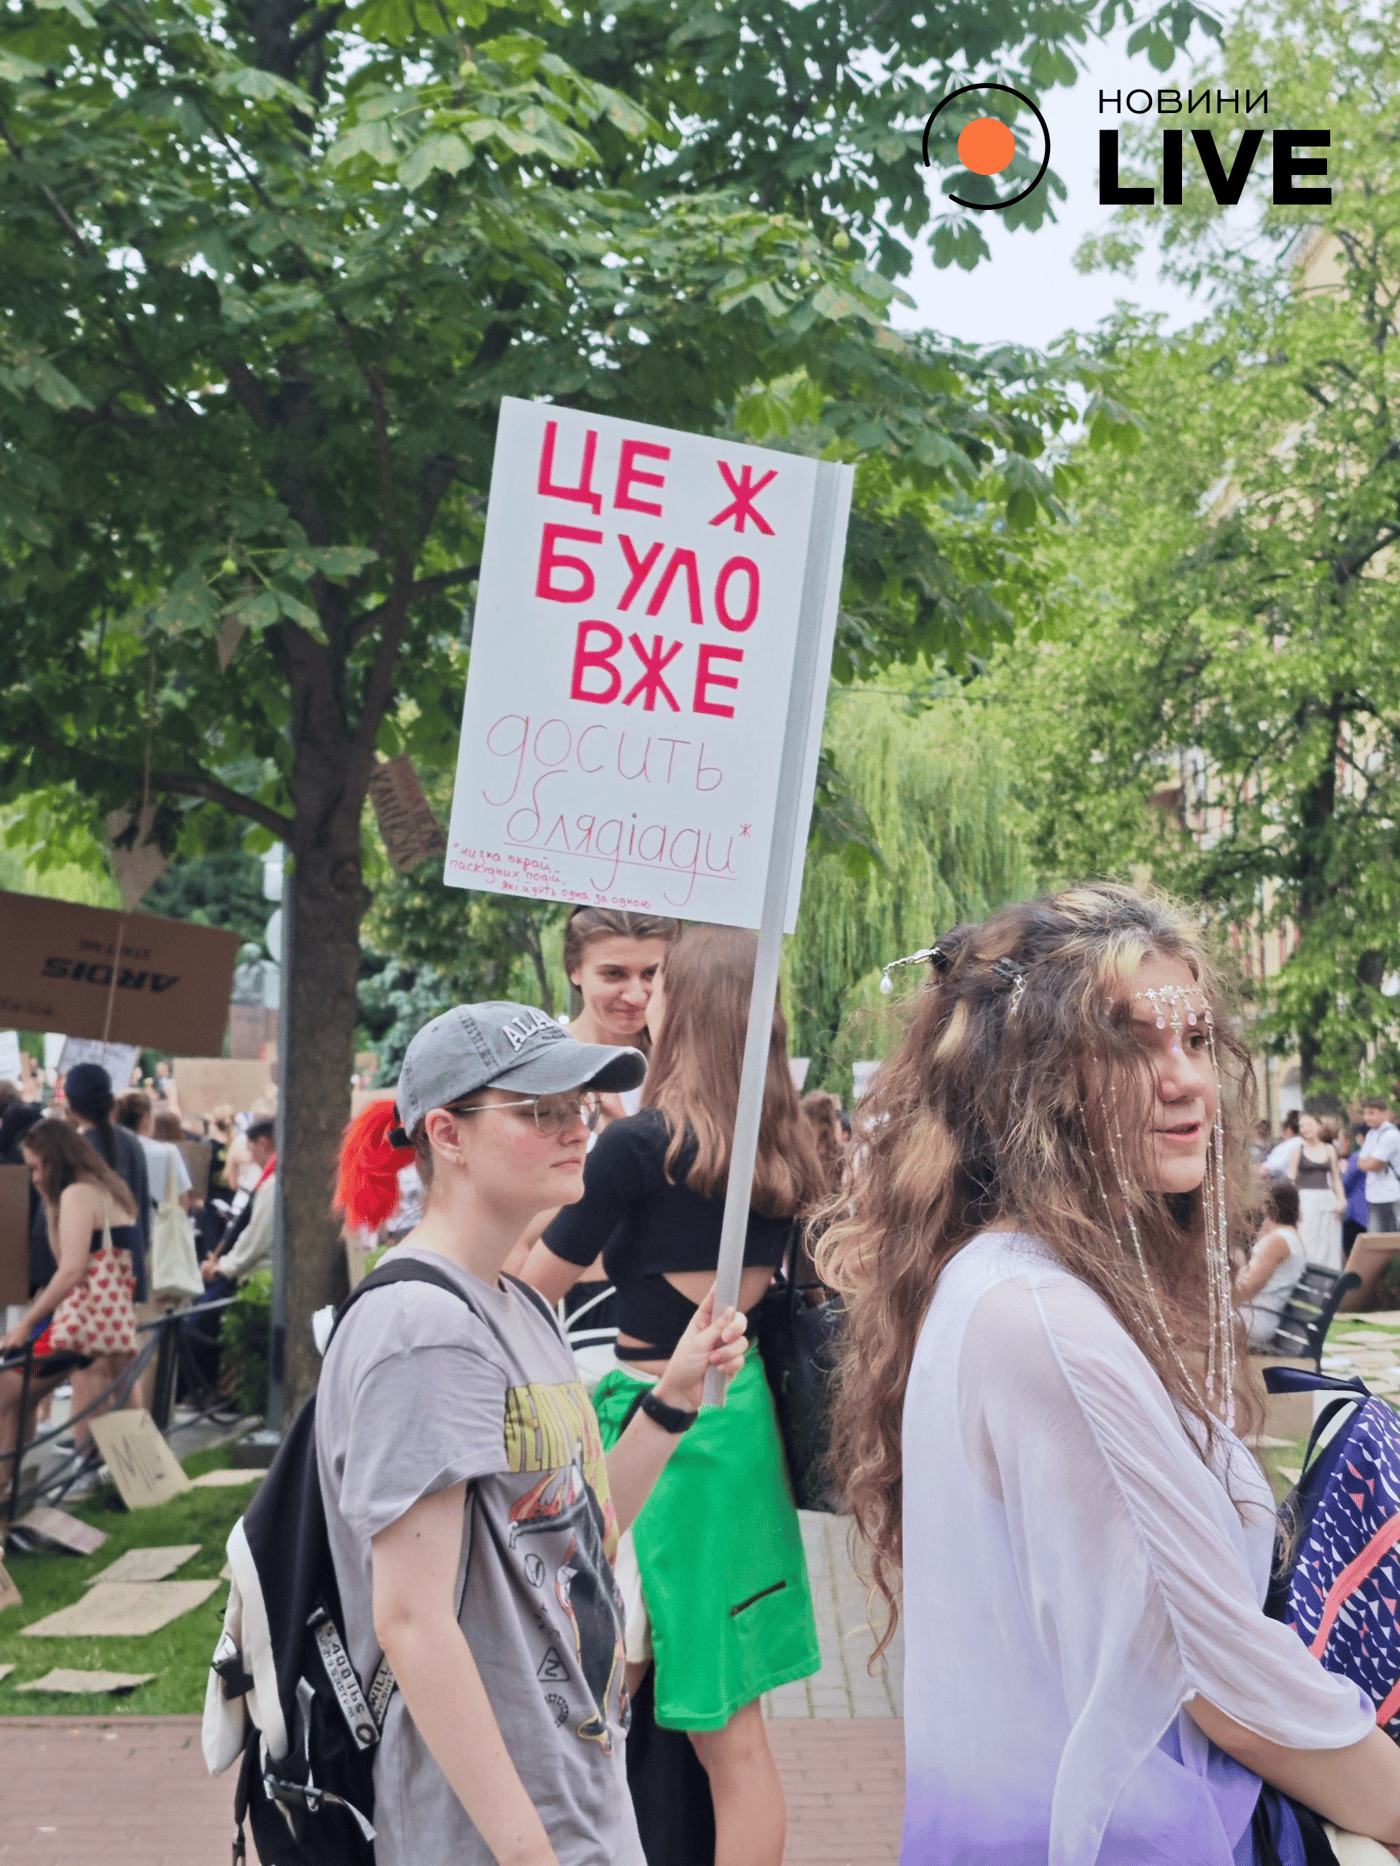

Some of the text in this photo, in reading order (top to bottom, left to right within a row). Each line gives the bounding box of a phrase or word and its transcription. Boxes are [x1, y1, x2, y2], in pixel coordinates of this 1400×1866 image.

[537, 421, 779, 536] ЦЕ Ж
[535, 522, 760, 632] БУЛО
[570, 620, 744, 718] ВЖЕ
[482, 714, 723, 806] досить
[42, 957, 181, 993] ARDIS
